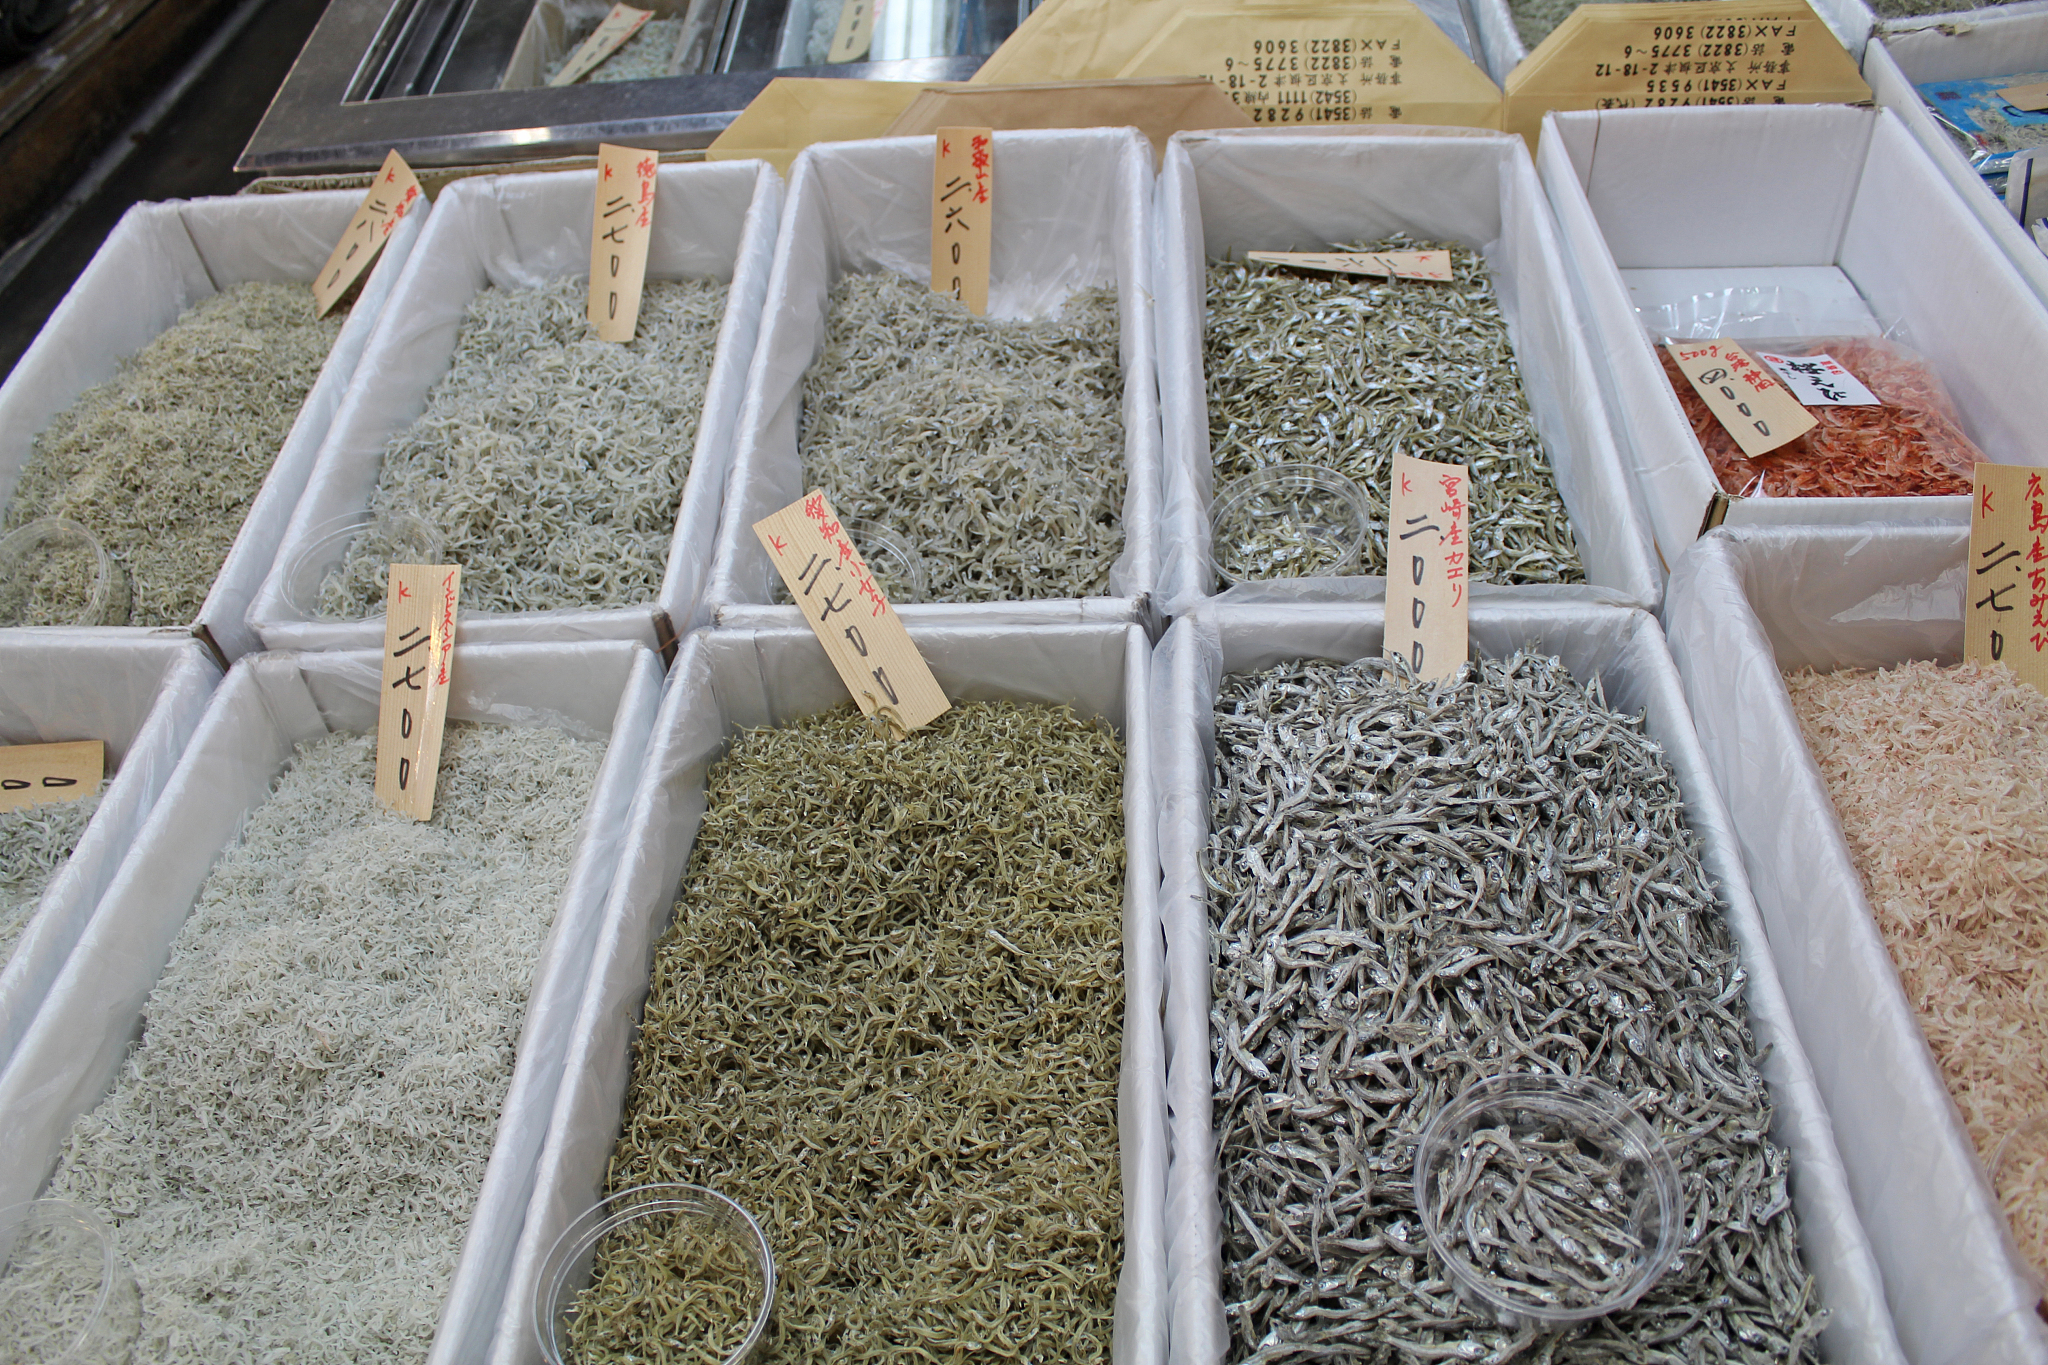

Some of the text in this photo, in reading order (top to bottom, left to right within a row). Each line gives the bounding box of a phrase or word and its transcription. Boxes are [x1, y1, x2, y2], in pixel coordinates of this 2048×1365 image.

[1595, 62, 1659, 77] 2-18-12
[1747, 60, 1790, 74] 事務所
[1359, 72, 1402, 86] 事務所
[1679, 344, 1722, 362] 500g
